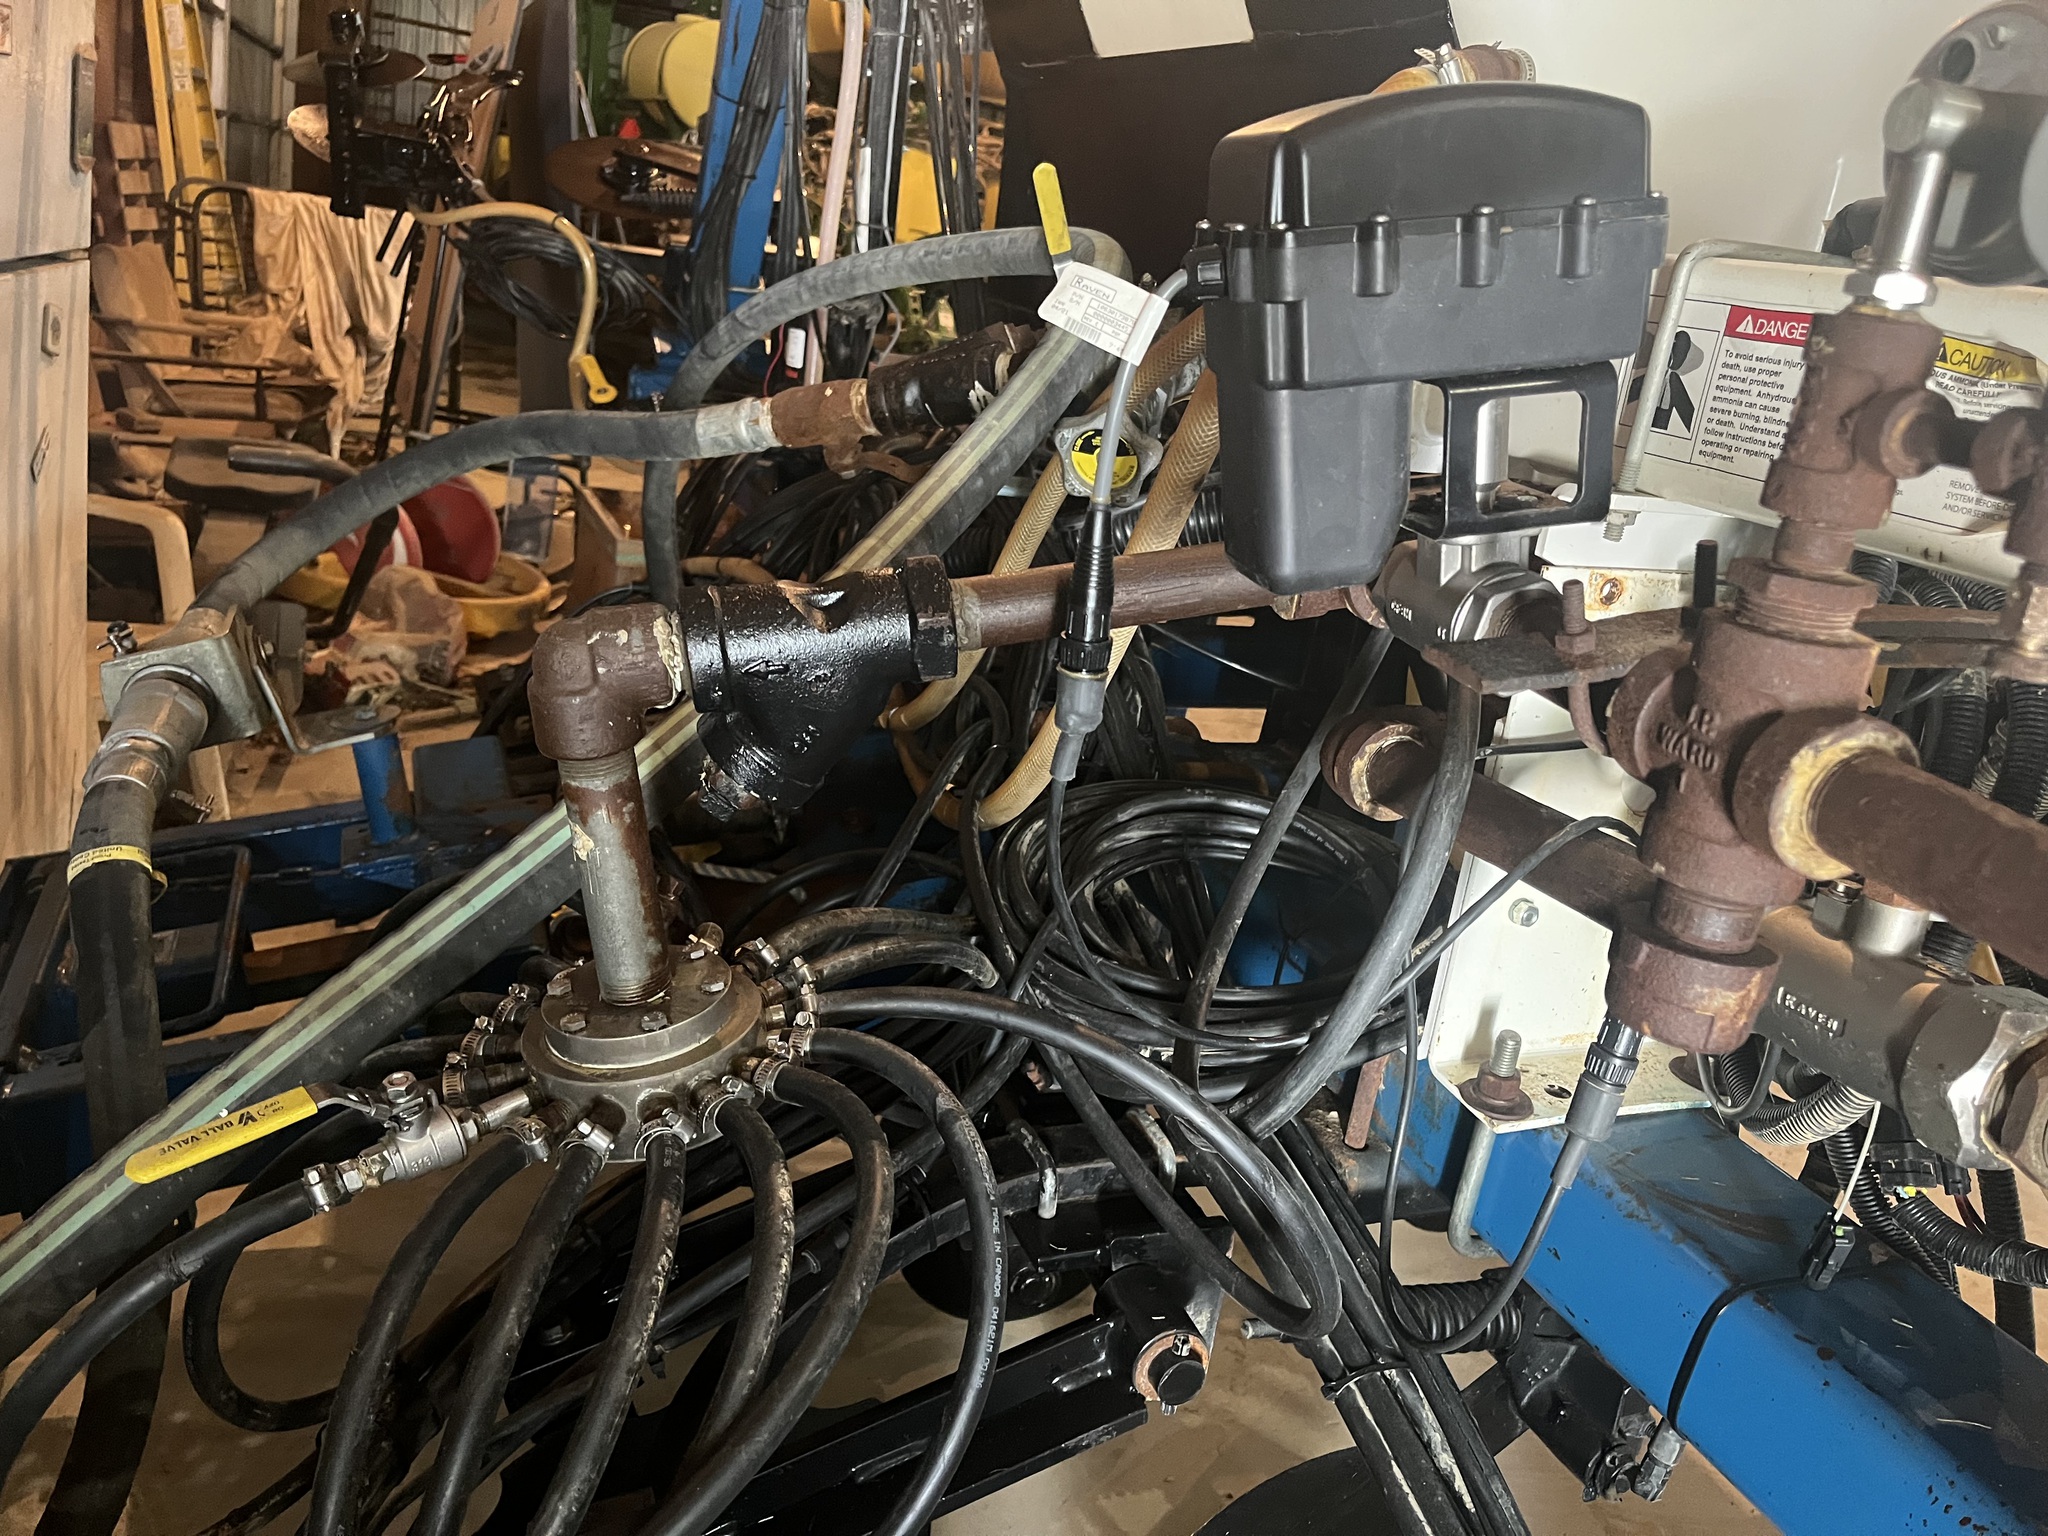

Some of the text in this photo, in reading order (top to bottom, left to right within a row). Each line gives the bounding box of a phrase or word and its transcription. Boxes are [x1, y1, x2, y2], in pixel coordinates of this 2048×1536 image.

[1074, 277, 1111, 301] RAVEN
[1754, 319, 1810, 340] DANGE
[1721, 361, 1782, 378] death, use proper
[1725, 350, 1805, 371] To avoid serious injury
[1949, 348, 2011, 379] CAUTION
[1715, 384, 1752, 396] equipment.
[1718, 373, 1785, 390] personal protective
[1712, 395, 1781, 413] ammonia can cause
[1709, 406, 1789, 428] severe burning, blindne
[1715, 418, 1736, 429] death.
[1739, 422, 1780, 438] Understand
[1704, 427, 1785, 451] follow instructions befo
[1698, 449, 1734, 463] equipment.
[1701, 438, 1775, 462] operating or repairing
[1945, 492, 1974, 504] SYSTEM
[1974, 498, 2001, 511] BEFORE
[1785, 994, 1839, 1031] RAVEN
[159, 1120, 234, 1156] BALL VALVE
[992, 1207, 1001, 1234] MADE
[994, 1241, 1002, 1253] IN
[994, 1257, 1003, 1298] CANADA
